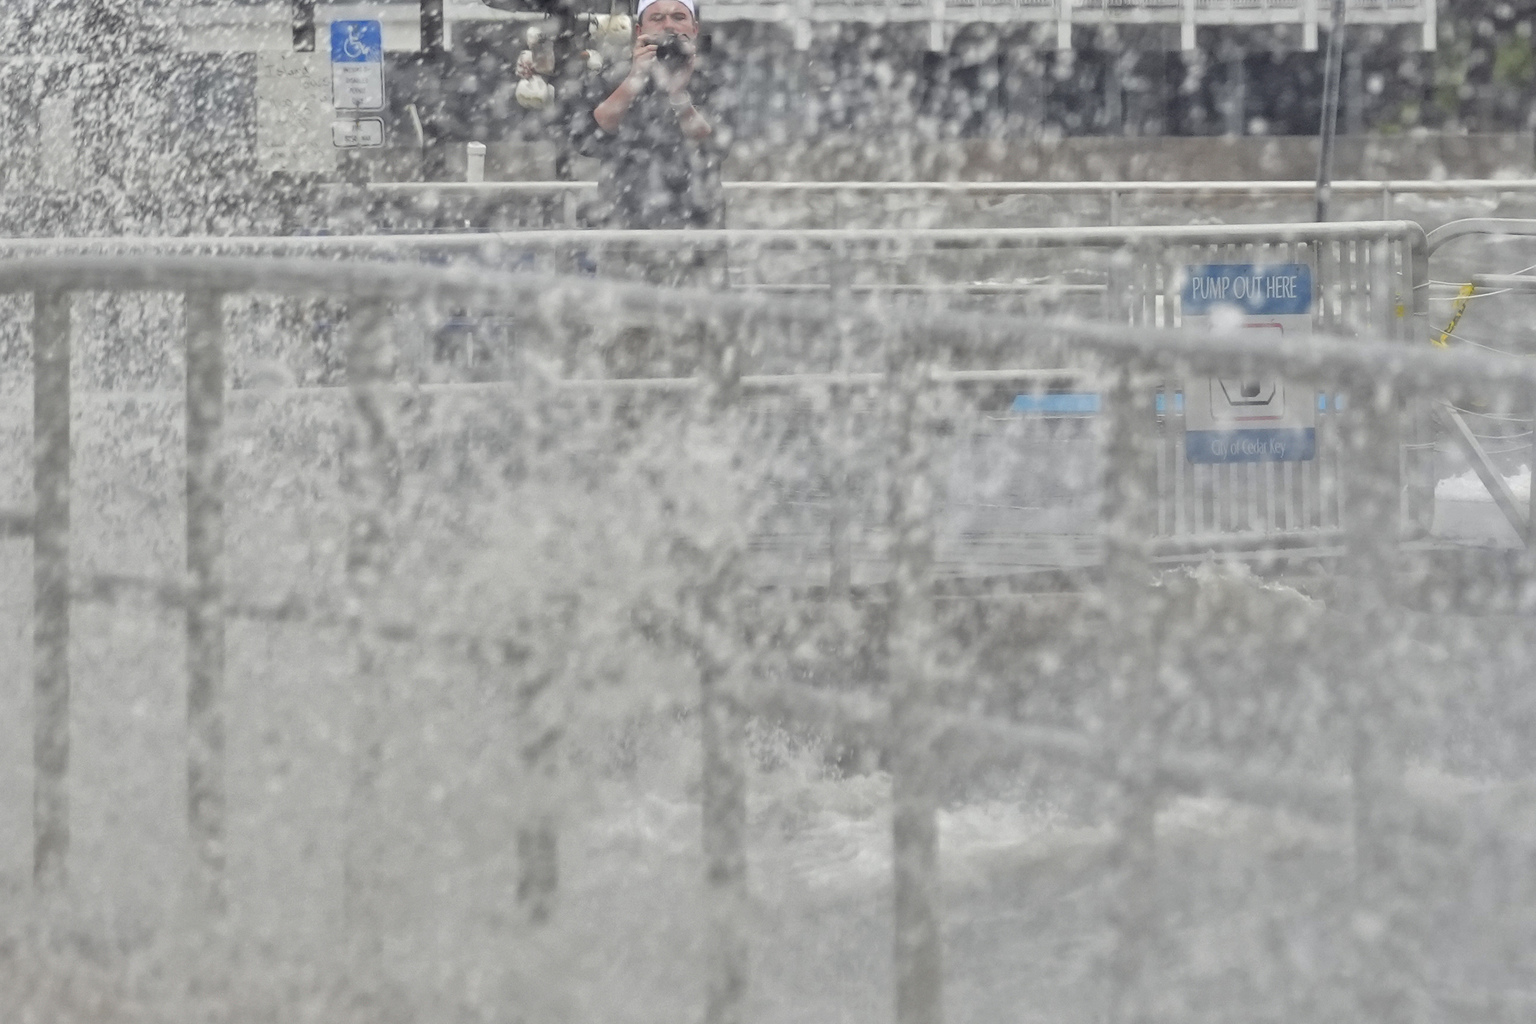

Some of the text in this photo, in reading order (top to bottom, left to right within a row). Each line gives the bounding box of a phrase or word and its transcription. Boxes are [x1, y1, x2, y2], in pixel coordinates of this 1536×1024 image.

[1192, 275, 1298, 299] PUMP OUT HERE
[1211, 438, 1286, 460] City of Cedar Key
